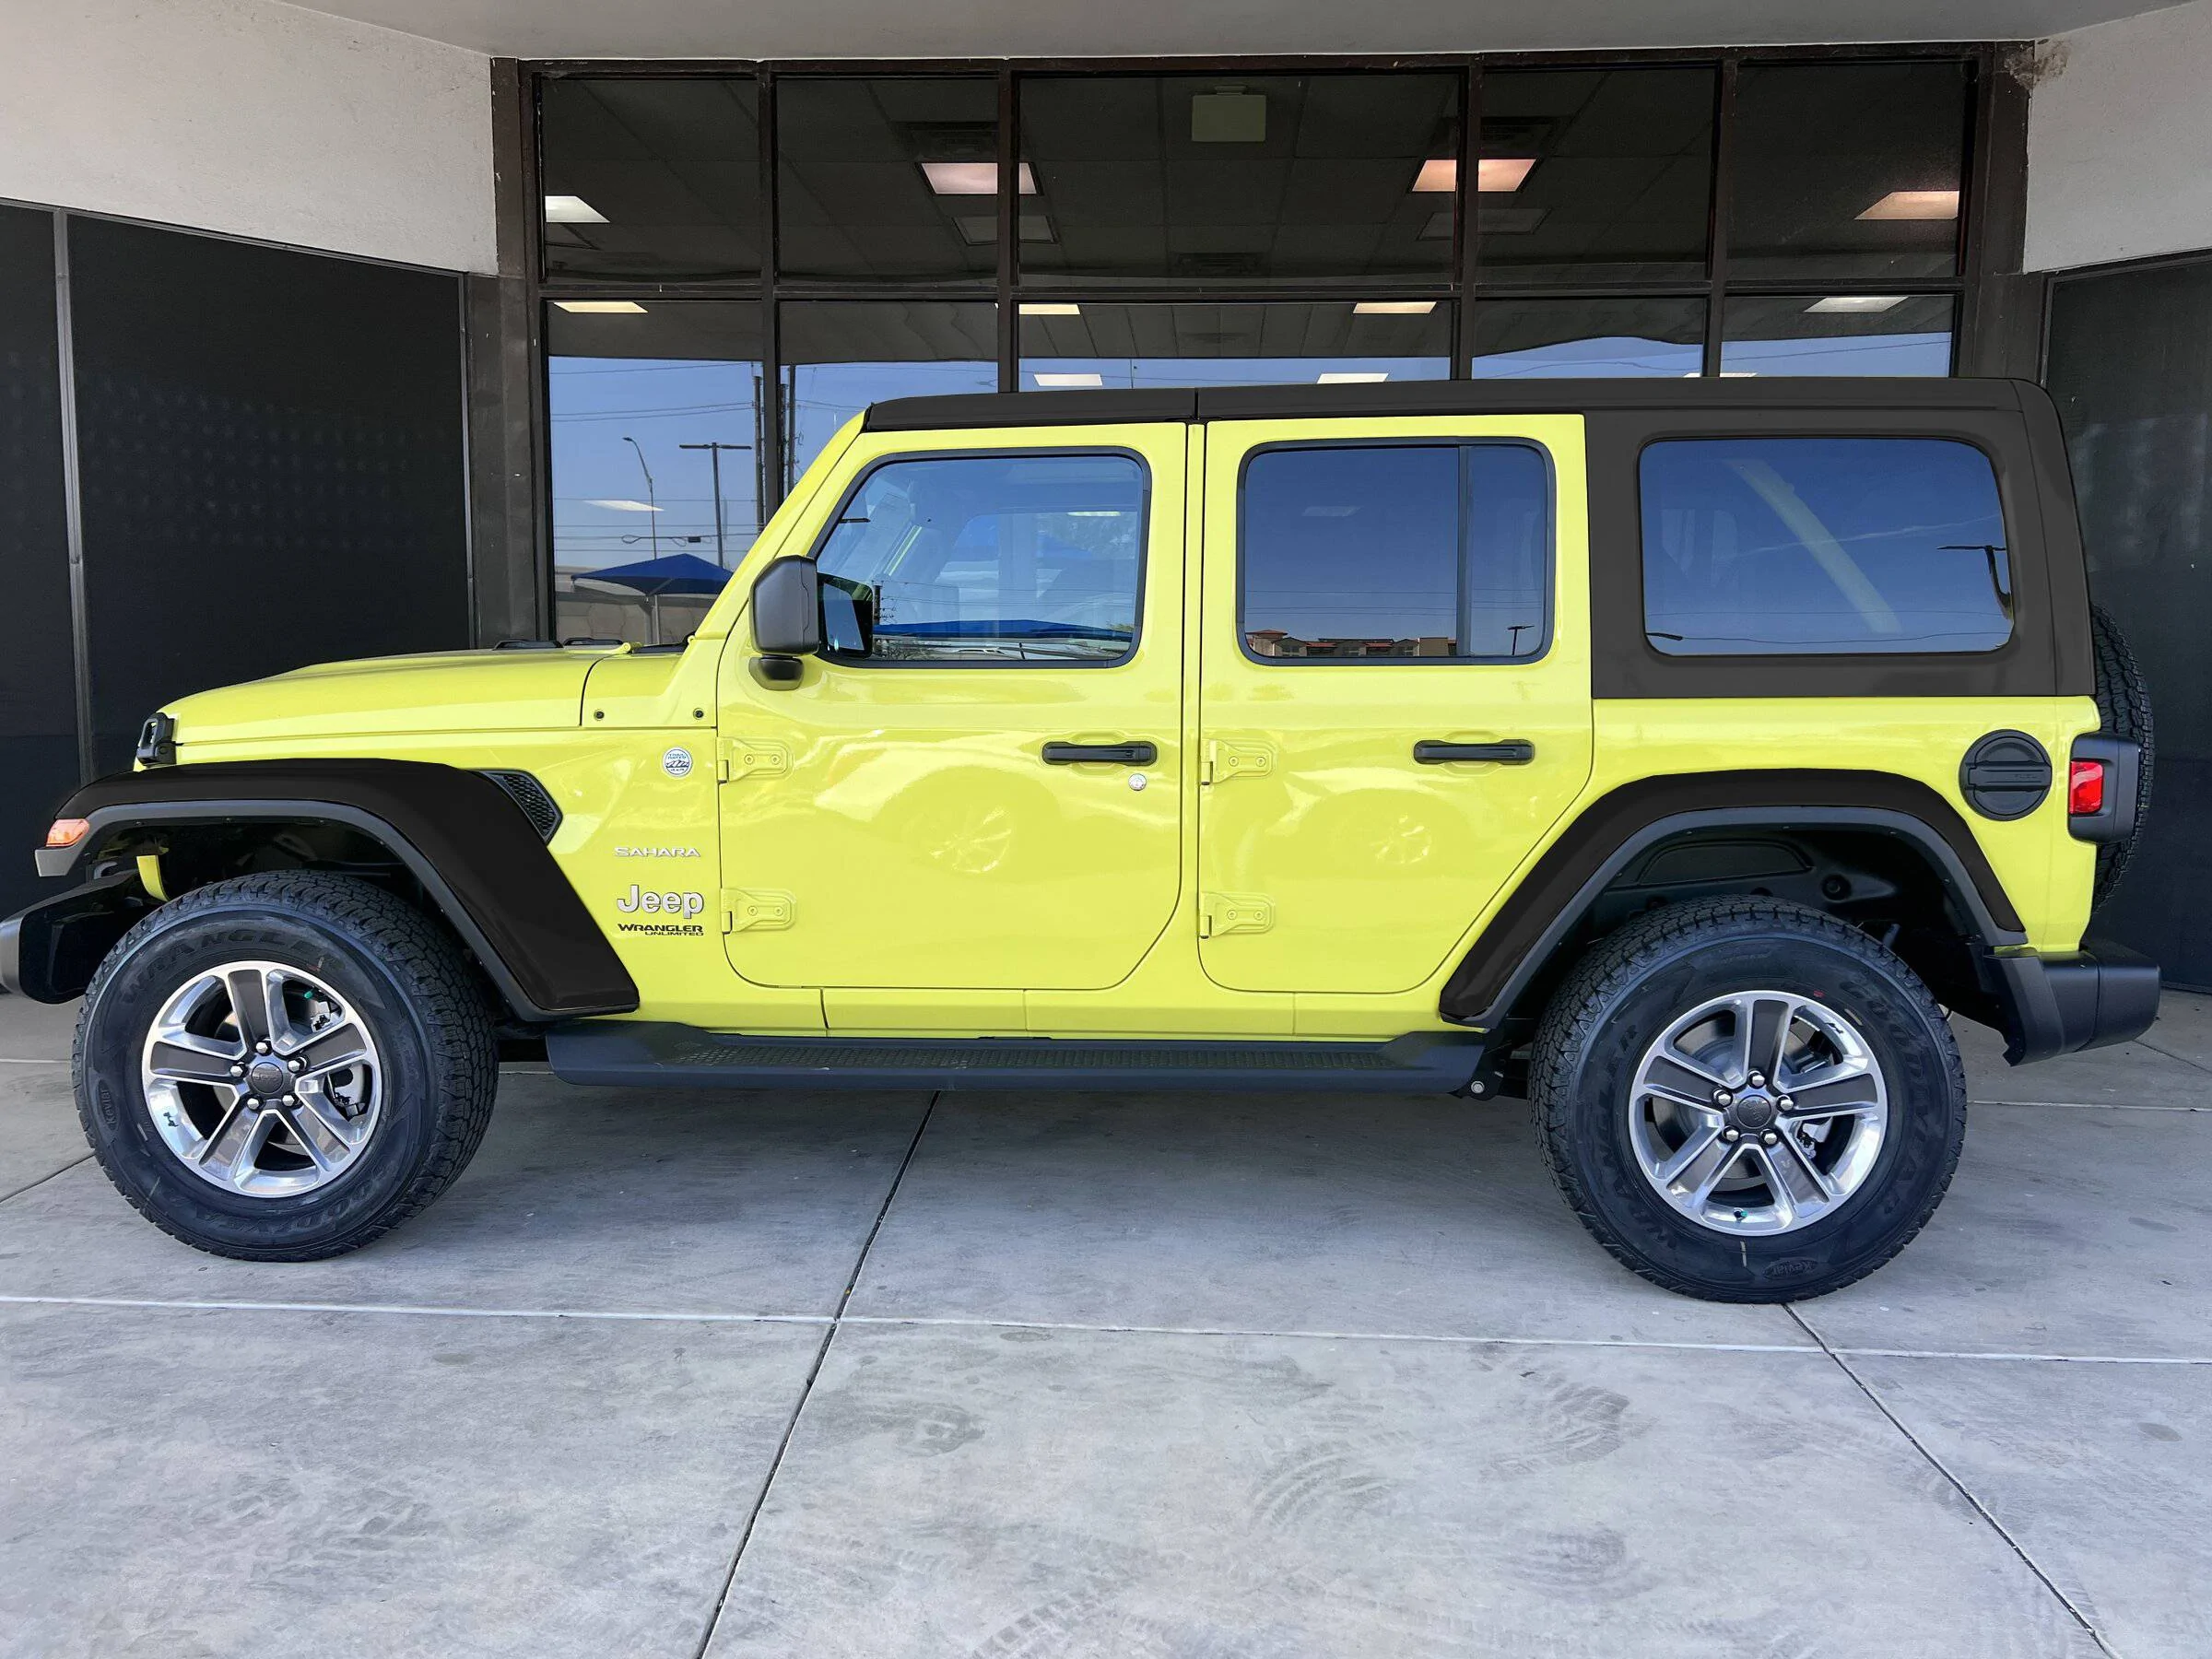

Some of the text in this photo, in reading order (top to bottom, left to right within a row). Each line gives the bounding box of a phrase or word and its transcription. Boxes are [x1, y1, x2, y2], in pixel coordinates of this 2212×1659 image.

[614, 847, 700, 857] SAHARA
[617, 884, 704, 919] Jeep
[618, 924, 703, 933] WRANGLER
